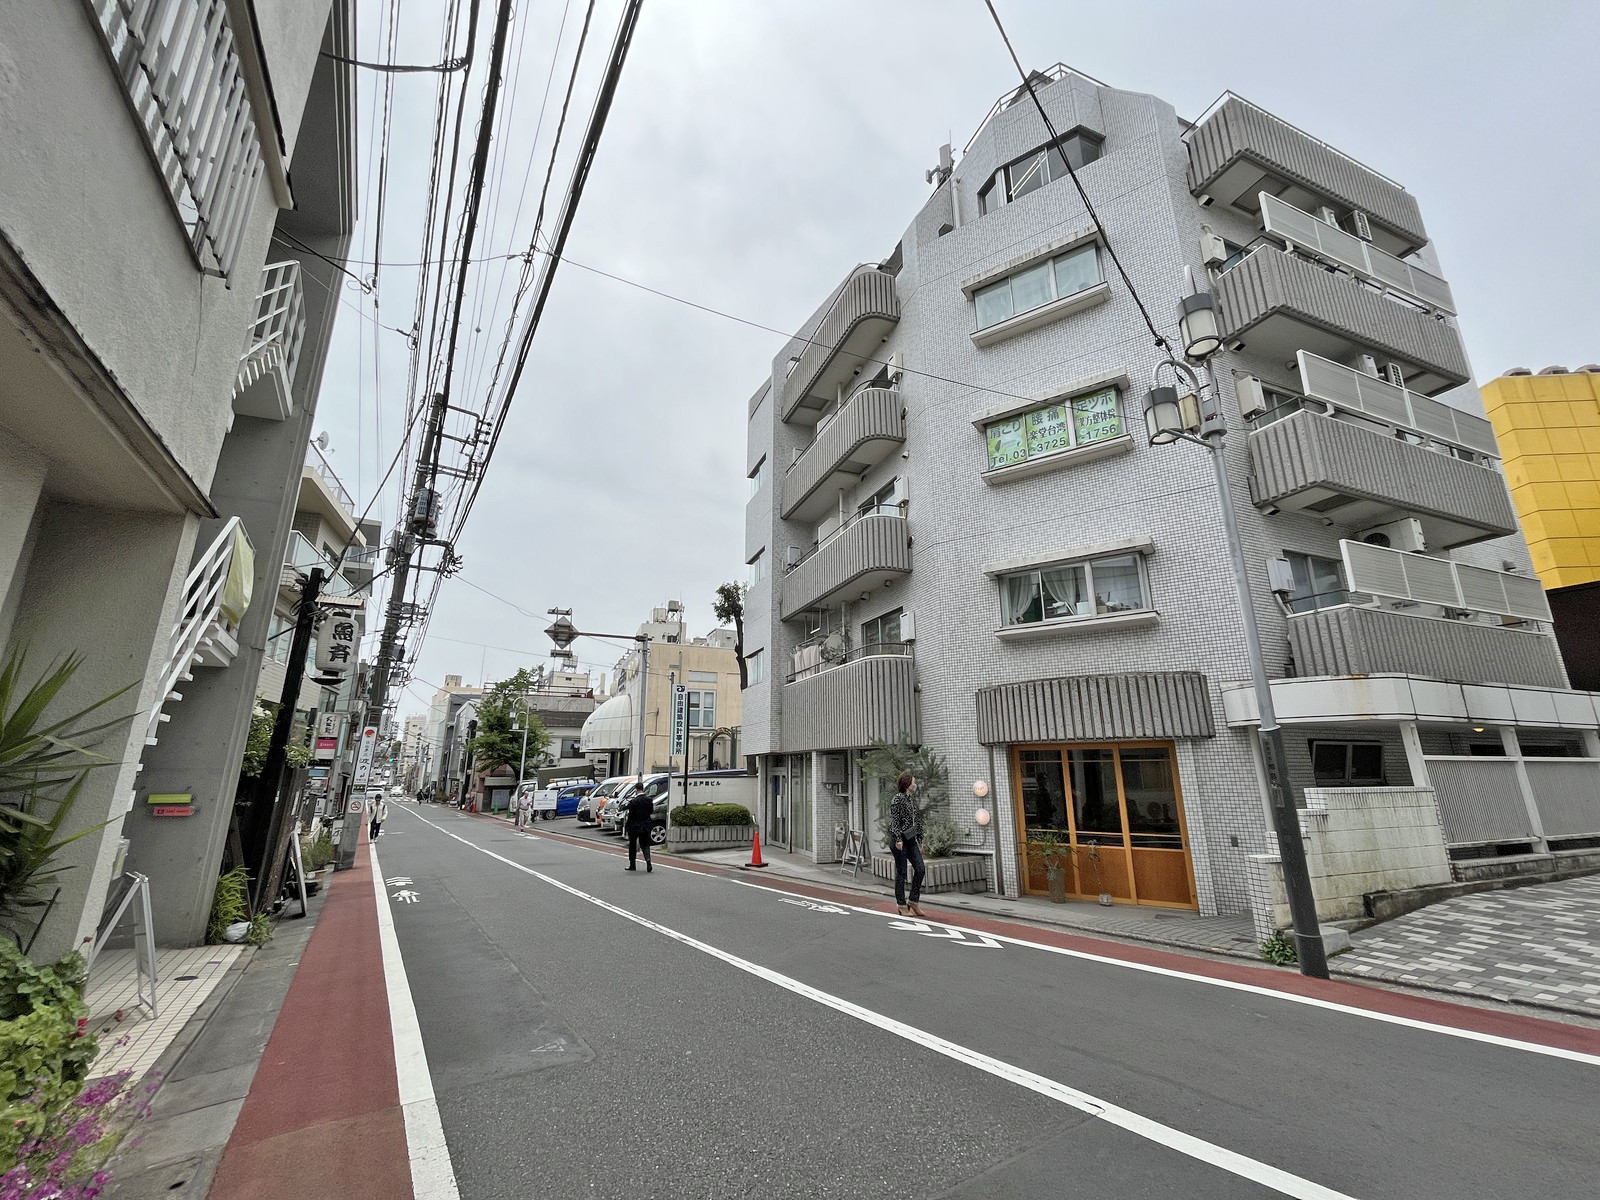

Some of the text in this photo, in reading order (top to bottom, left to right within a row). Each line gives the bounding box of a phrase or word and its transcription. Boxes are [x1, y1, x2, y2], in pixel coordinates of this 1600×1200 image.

[990, 419, 1021, 439] 肩こり
[1031, 406, 1060, 426] 腰痛
[990, 448, 1027, 469] Tel.03
[675, 693, 683, 755] 自由建築設計事務所
